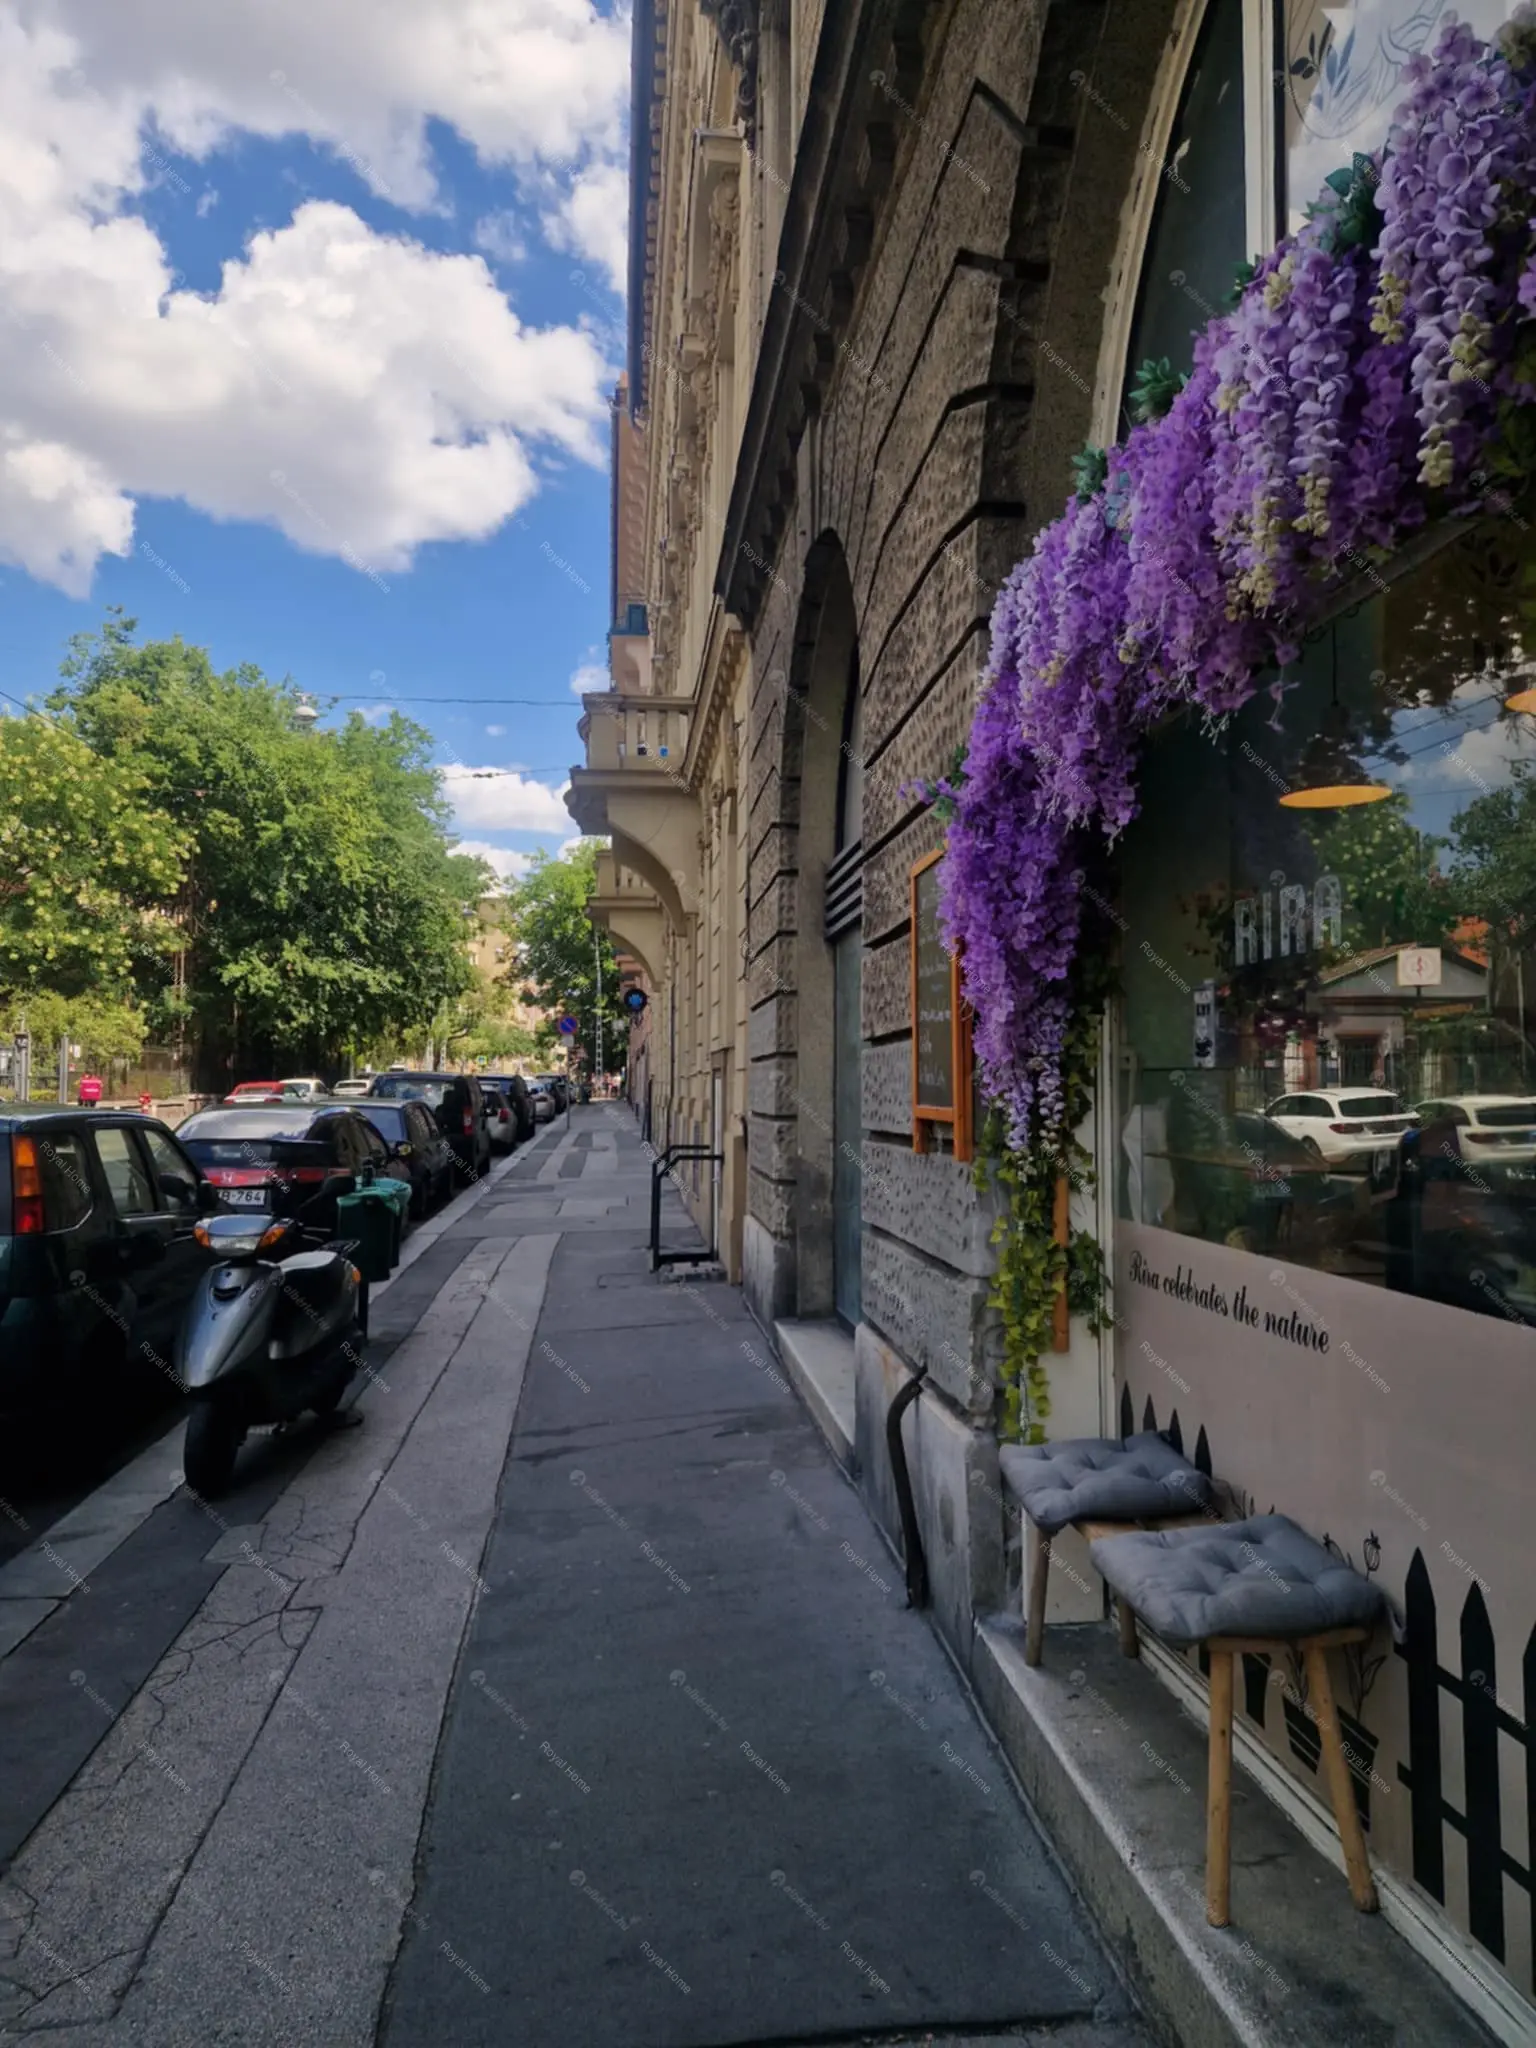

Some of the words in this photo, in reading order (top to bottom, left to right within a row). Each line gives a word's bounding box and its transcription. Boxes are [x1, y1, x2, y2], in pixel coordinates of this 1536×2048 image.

[1235, 874, 1341, 966] RIRA
[1163, 1265, 1228, 1317] celebrates
[1233, 1285, 1259, 1328] the
[1264, 1310, 1330, 1355] nature
